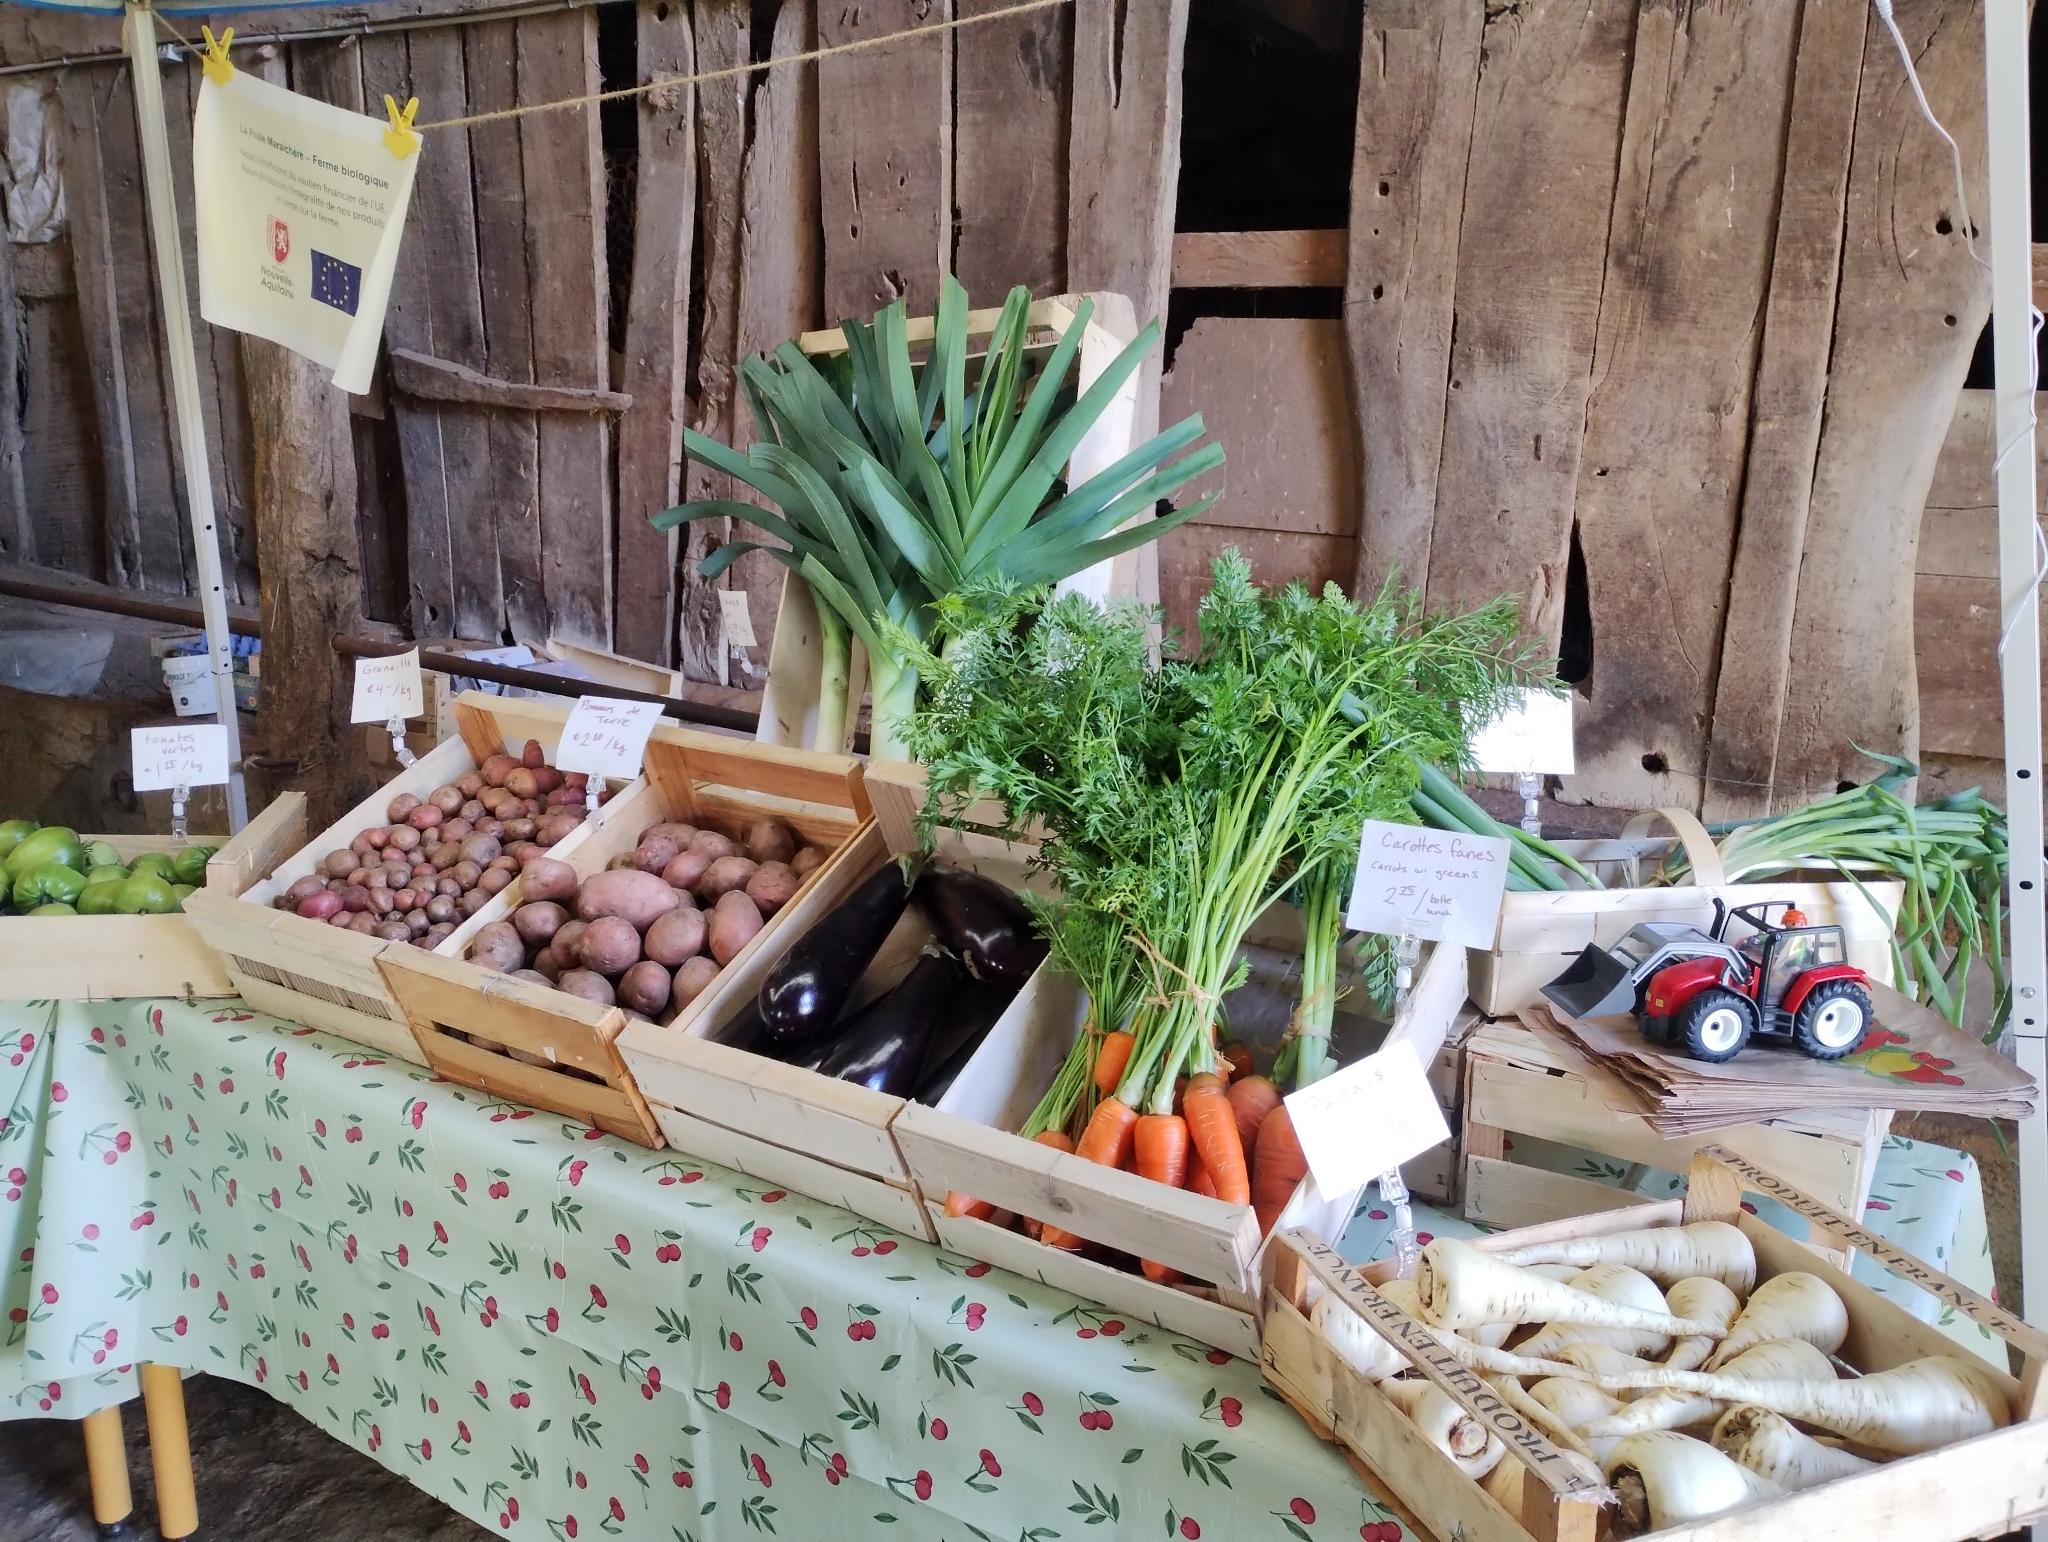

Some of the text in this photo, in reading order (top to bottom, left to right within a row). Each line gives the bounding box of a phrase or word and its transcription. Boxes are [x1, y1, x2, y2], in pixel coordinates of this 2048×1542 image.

[239, 122, 248, 134] La
[312, 154, 339, 173] Ferme
[341, 165, 389, 189] biologique
[297, 176, 322, 191] soutien
[324, 183, 356, 203] financier
[358, 196, 369, 208] de
[325, 200, 335, 210] de
[336, 206, 351, 217] nos
[353, 211, 385, 230] produits
[260, 277, 295, 300] Aquitaine
[594, 715, 630, 727] Terre
[625, 705, 641, 715] de
[161, 744, 195, 755] vertes
[1381, 831, 1496, 863] Carottes fanes
[1435, 868, 1480, 881] greens
[1724, 1157, 1850, 1229] PRODUIT
[1307, 1243, 1401, 1321] FRANCE
[1425, 1354, 1561, 1464] PRODUIT
